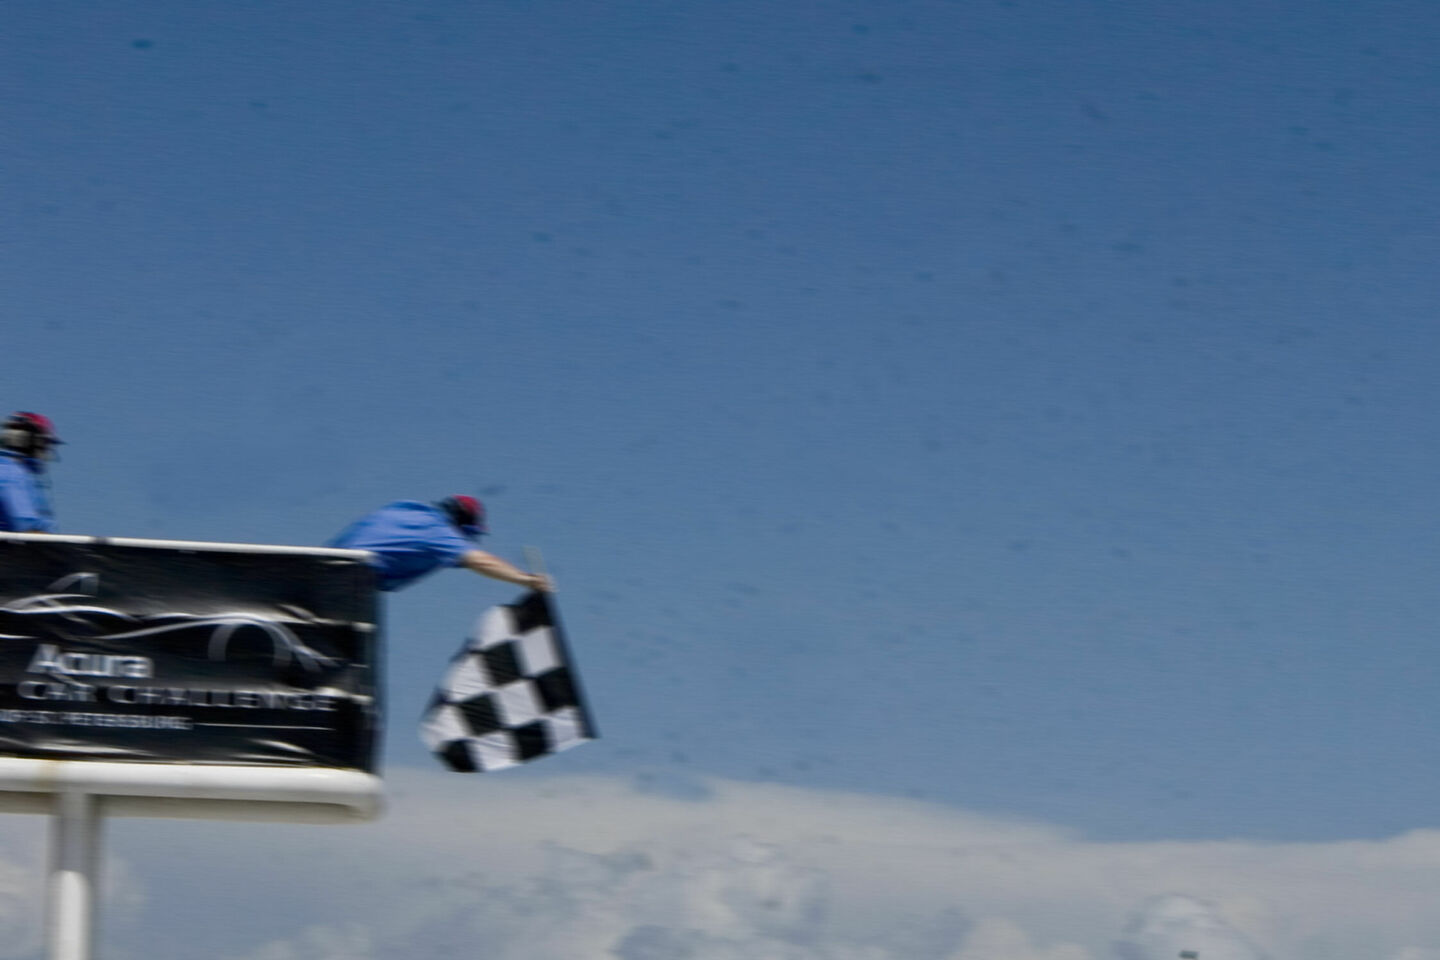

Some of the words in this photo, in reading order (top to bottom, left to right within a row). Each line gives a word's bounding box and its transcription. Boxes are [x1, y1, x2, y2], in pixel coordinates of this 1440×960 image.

[27, 644, 153, 678] Acura
[17, 680, 98, 702] CAR
[107, 684, 338, 711] CHALLENGE
